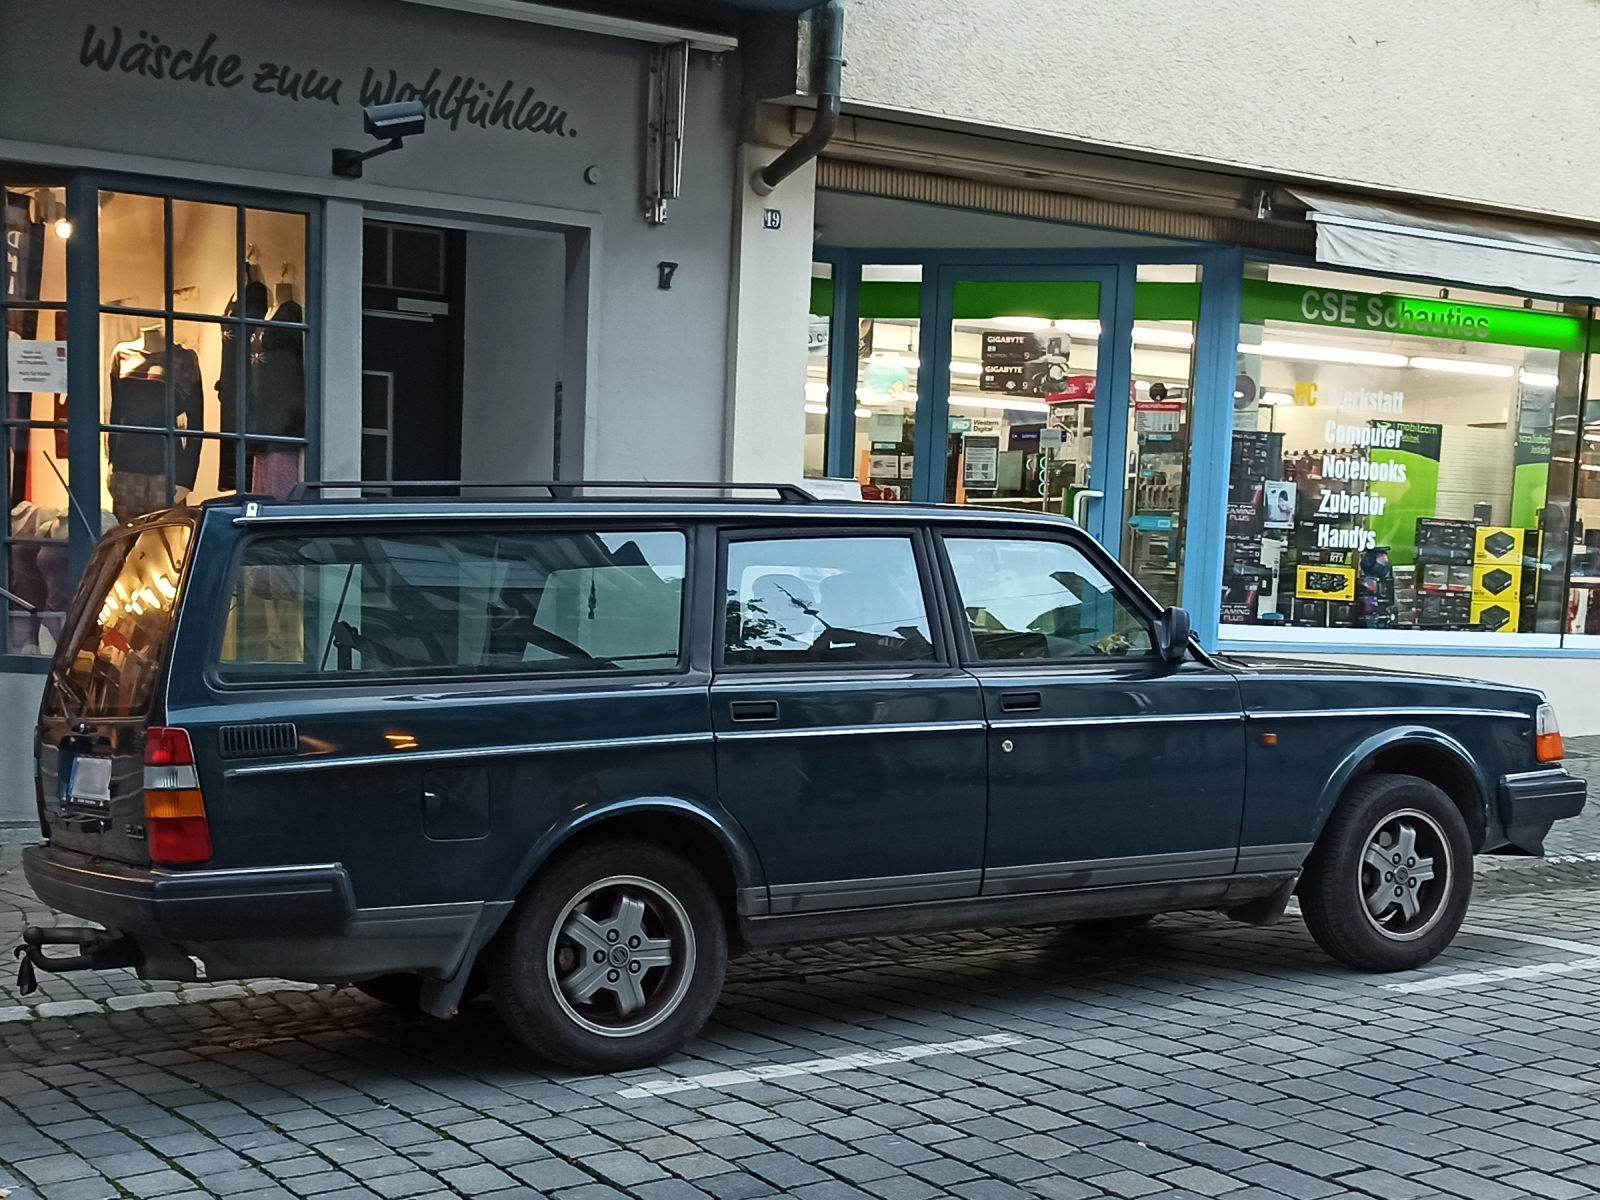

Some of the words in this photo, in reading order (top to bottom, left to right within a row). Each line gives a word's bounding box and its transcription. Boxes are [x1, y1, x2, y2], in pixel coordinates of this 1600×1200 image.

[79, 23, 245, 88] Wäsche
[252, 62, 344, 106] zum
[766, 211, 781, 228] 19
[1301, 290, 1359, 324] CSE
[1366, 297, 1490, 338] Schauties
[987, 336, 1025, 344] GIGABYTE
[985, 366, 1023, 374] GIGABYTE
[1294, 381, 1318, 407] PC
[1328, 386, 1404, 414] Werkstatt
[1325, 420, 1404, 448] Computer
[1322, 455, 1407, 483] Notebooks
[1318, 489, 1387, 516] Zubehör
[1316, 523, 1376, 551] Handys
